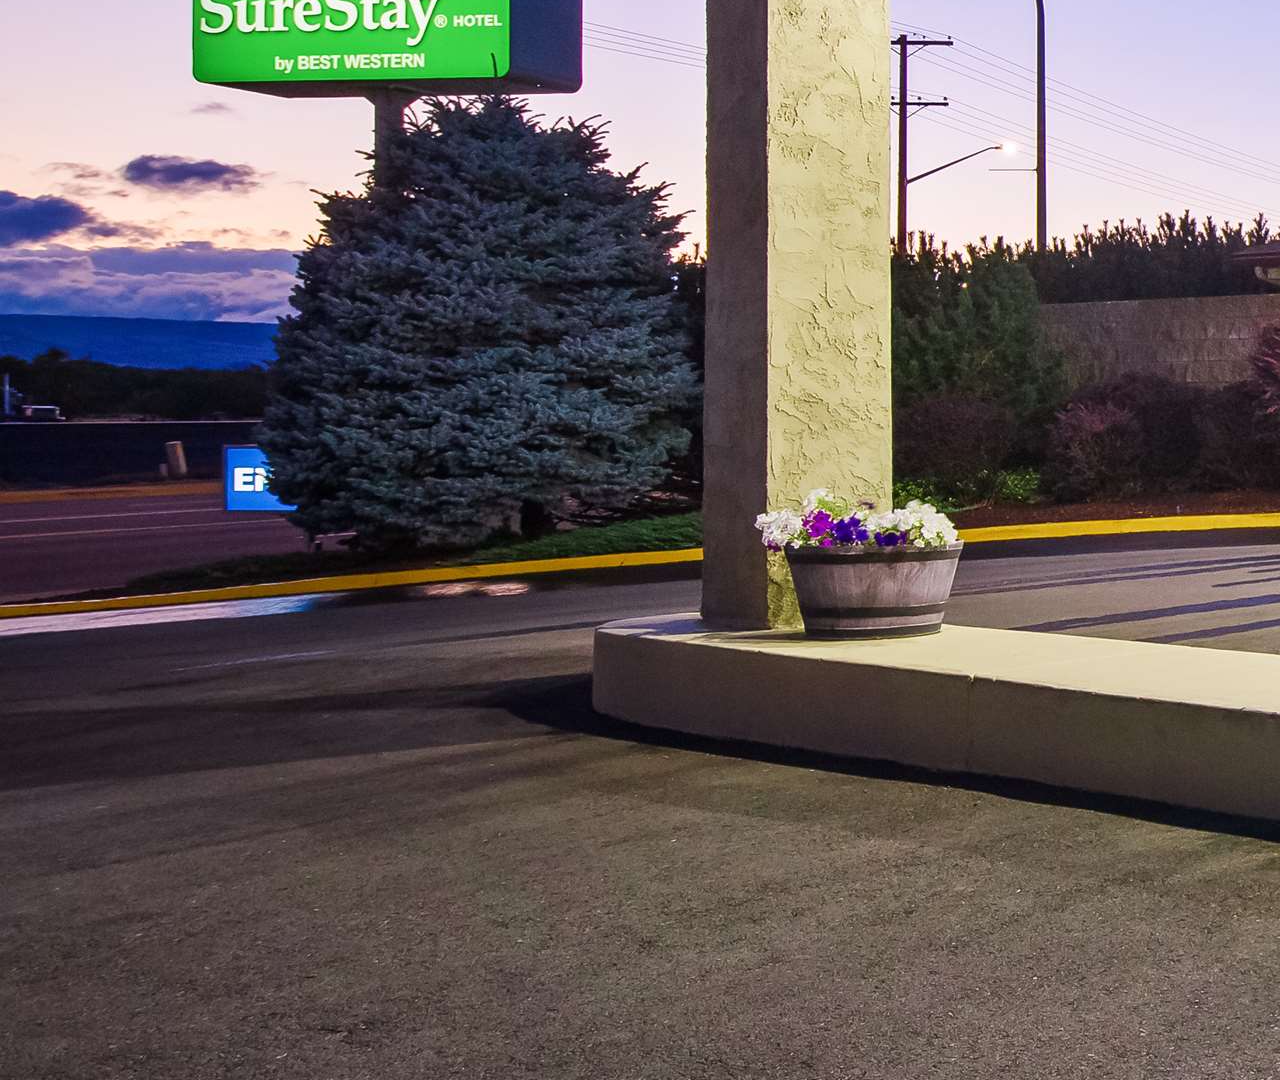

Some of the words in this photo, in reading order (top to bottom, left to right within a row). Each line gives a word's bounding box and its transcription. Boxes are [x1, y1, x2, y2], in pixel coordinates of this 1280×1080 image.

[453, 14, 503, 28] HOTEL
[274, 56, 295, 74] by
[297, 54, 341, 70] BEST
[343, 53, 425, 69] WESTERN
